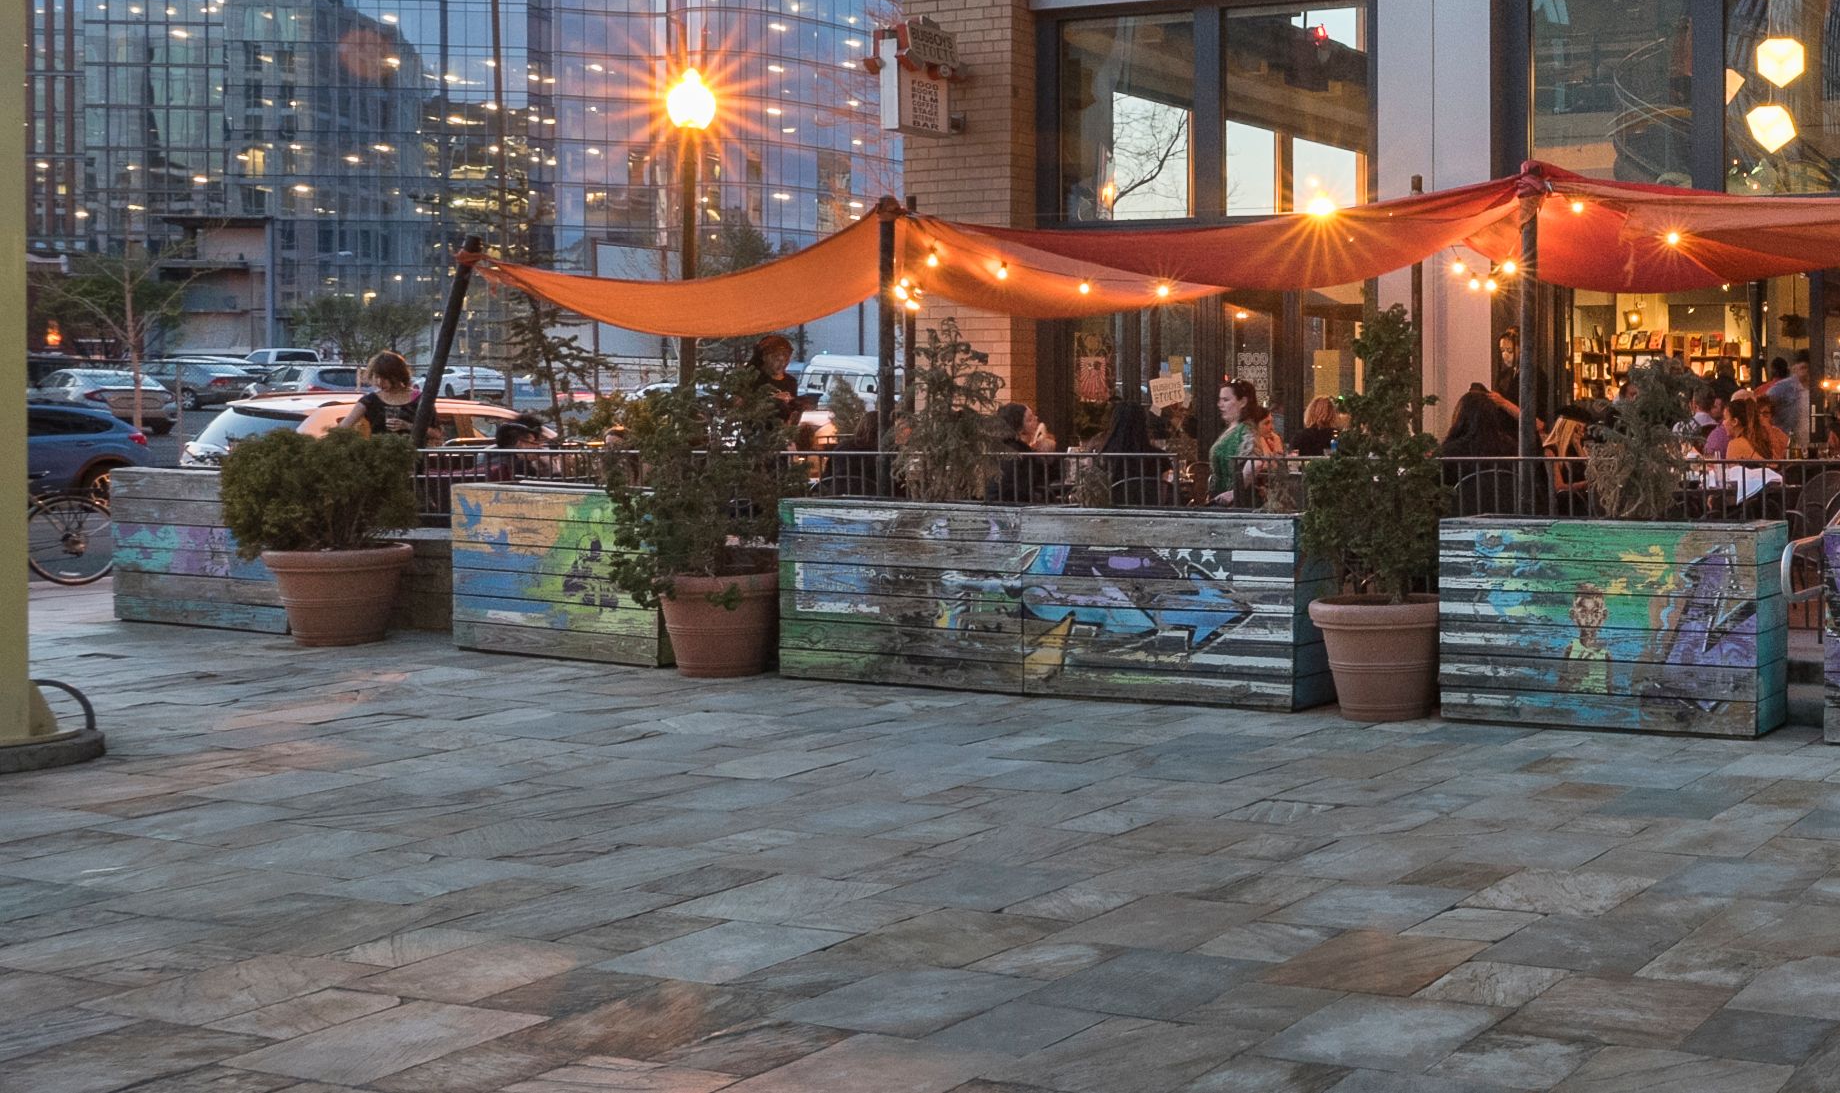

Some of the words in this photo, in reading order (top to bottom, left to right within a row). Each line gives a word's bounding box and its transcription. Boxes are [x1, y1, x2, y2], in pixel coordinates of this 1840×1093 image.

[911, 27, 953, 49] BUSBOYS
[922, 44, 956, 63] POETS
[911, 79, 939, 91] FOOD
[911, 86, 939, 97] BOOKS
[911, 93, 939, 104] FILM
[912, 100, 939, 109] COFFEE
[913, 107, 939, 117] STAGE
[913, 120, 940, 131] BAR
[1237, 352, 1269, 366] FOOD
